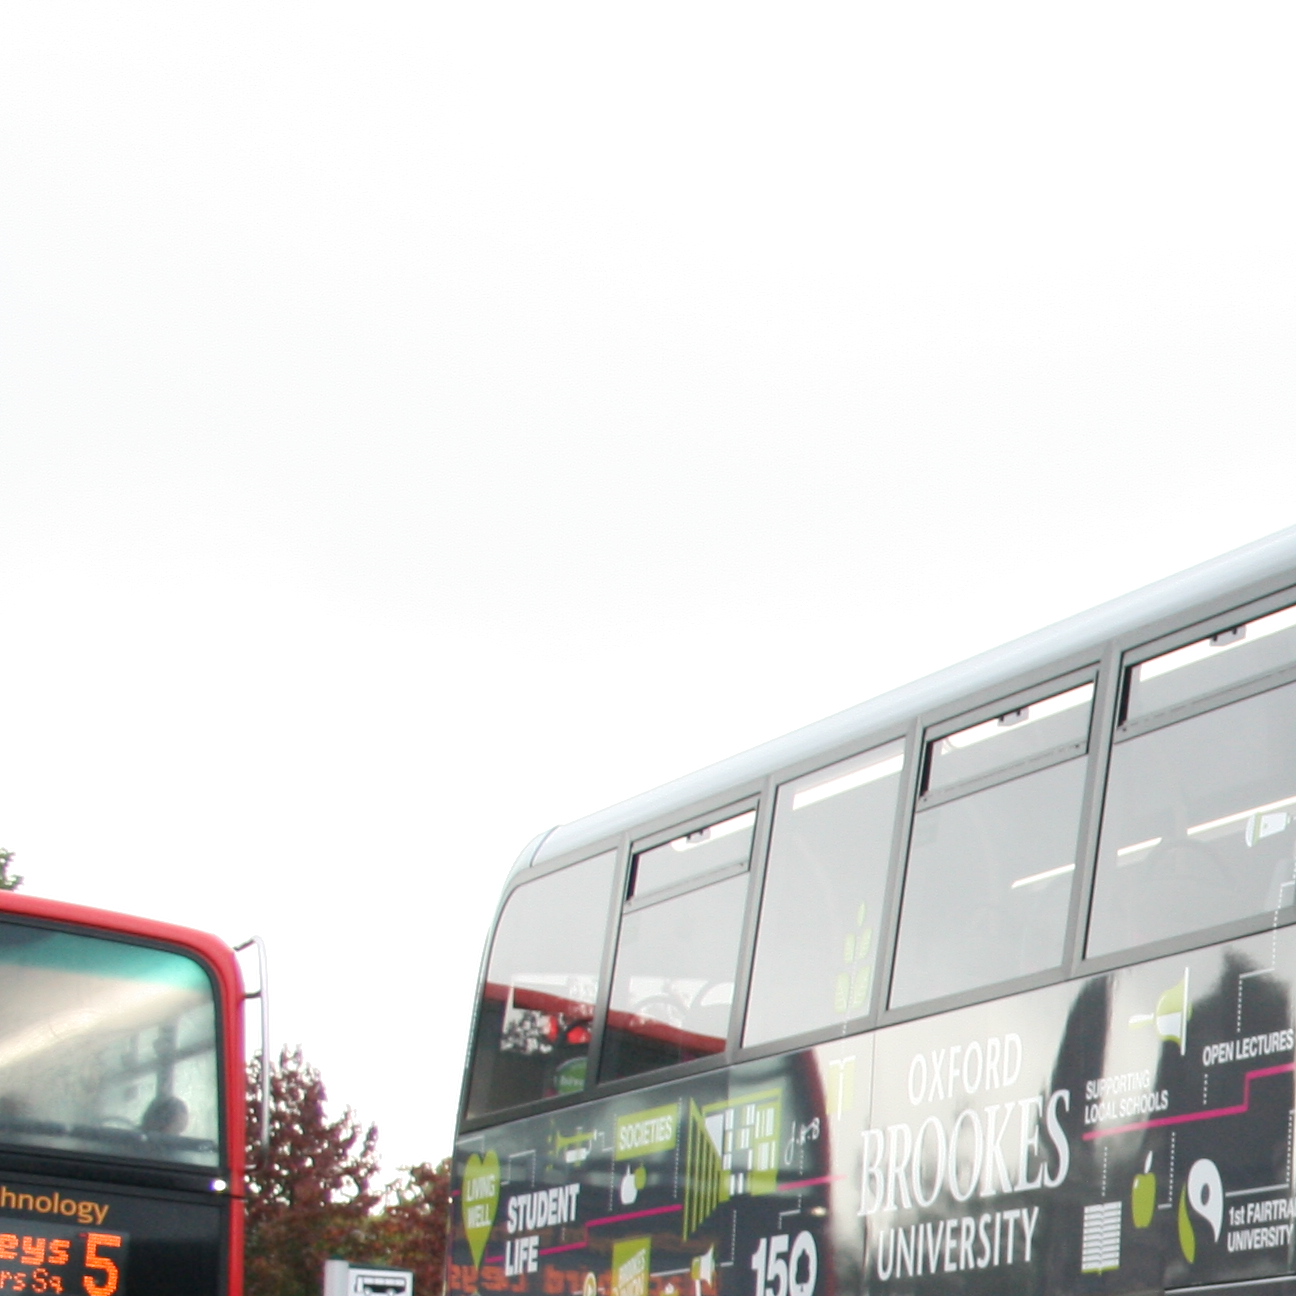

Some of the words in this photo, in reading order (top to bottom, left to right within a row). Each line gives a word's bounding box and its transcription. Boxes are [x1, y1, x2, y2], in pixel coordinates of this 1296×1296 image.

[1202, 1040, 1234, 1066] OPEN
[1236, 1028, 1295, 1061] LECTURES
[907, 1033, 1023, 1107] OXFORD
[1085, 1069, 1151, 1100] SUPPORTING
[1084, 1099, 1117, 1124] LOCAL
[1119, 1090, 1169, 1118] SCHOOLS
[619, 1115, 674, 1150] SOCIETIES
[857, 1089, 1071, 1218] BROOKES
[0, 1186, 109, 1225] hnology
[467, 1174, 496, 1201] LIVING
[467, 1203, 492, 1230] WELL
[506, 1183, 580, 1234] STUDENT
[1228, 1204, 1246, 1226] 1st
[504, 1235, 540, 1277] LIFE
[876, 1206, 1040, 1282] UNIVERSITY
[1226, 1223, 1296, 1253] UNIVERSITY
